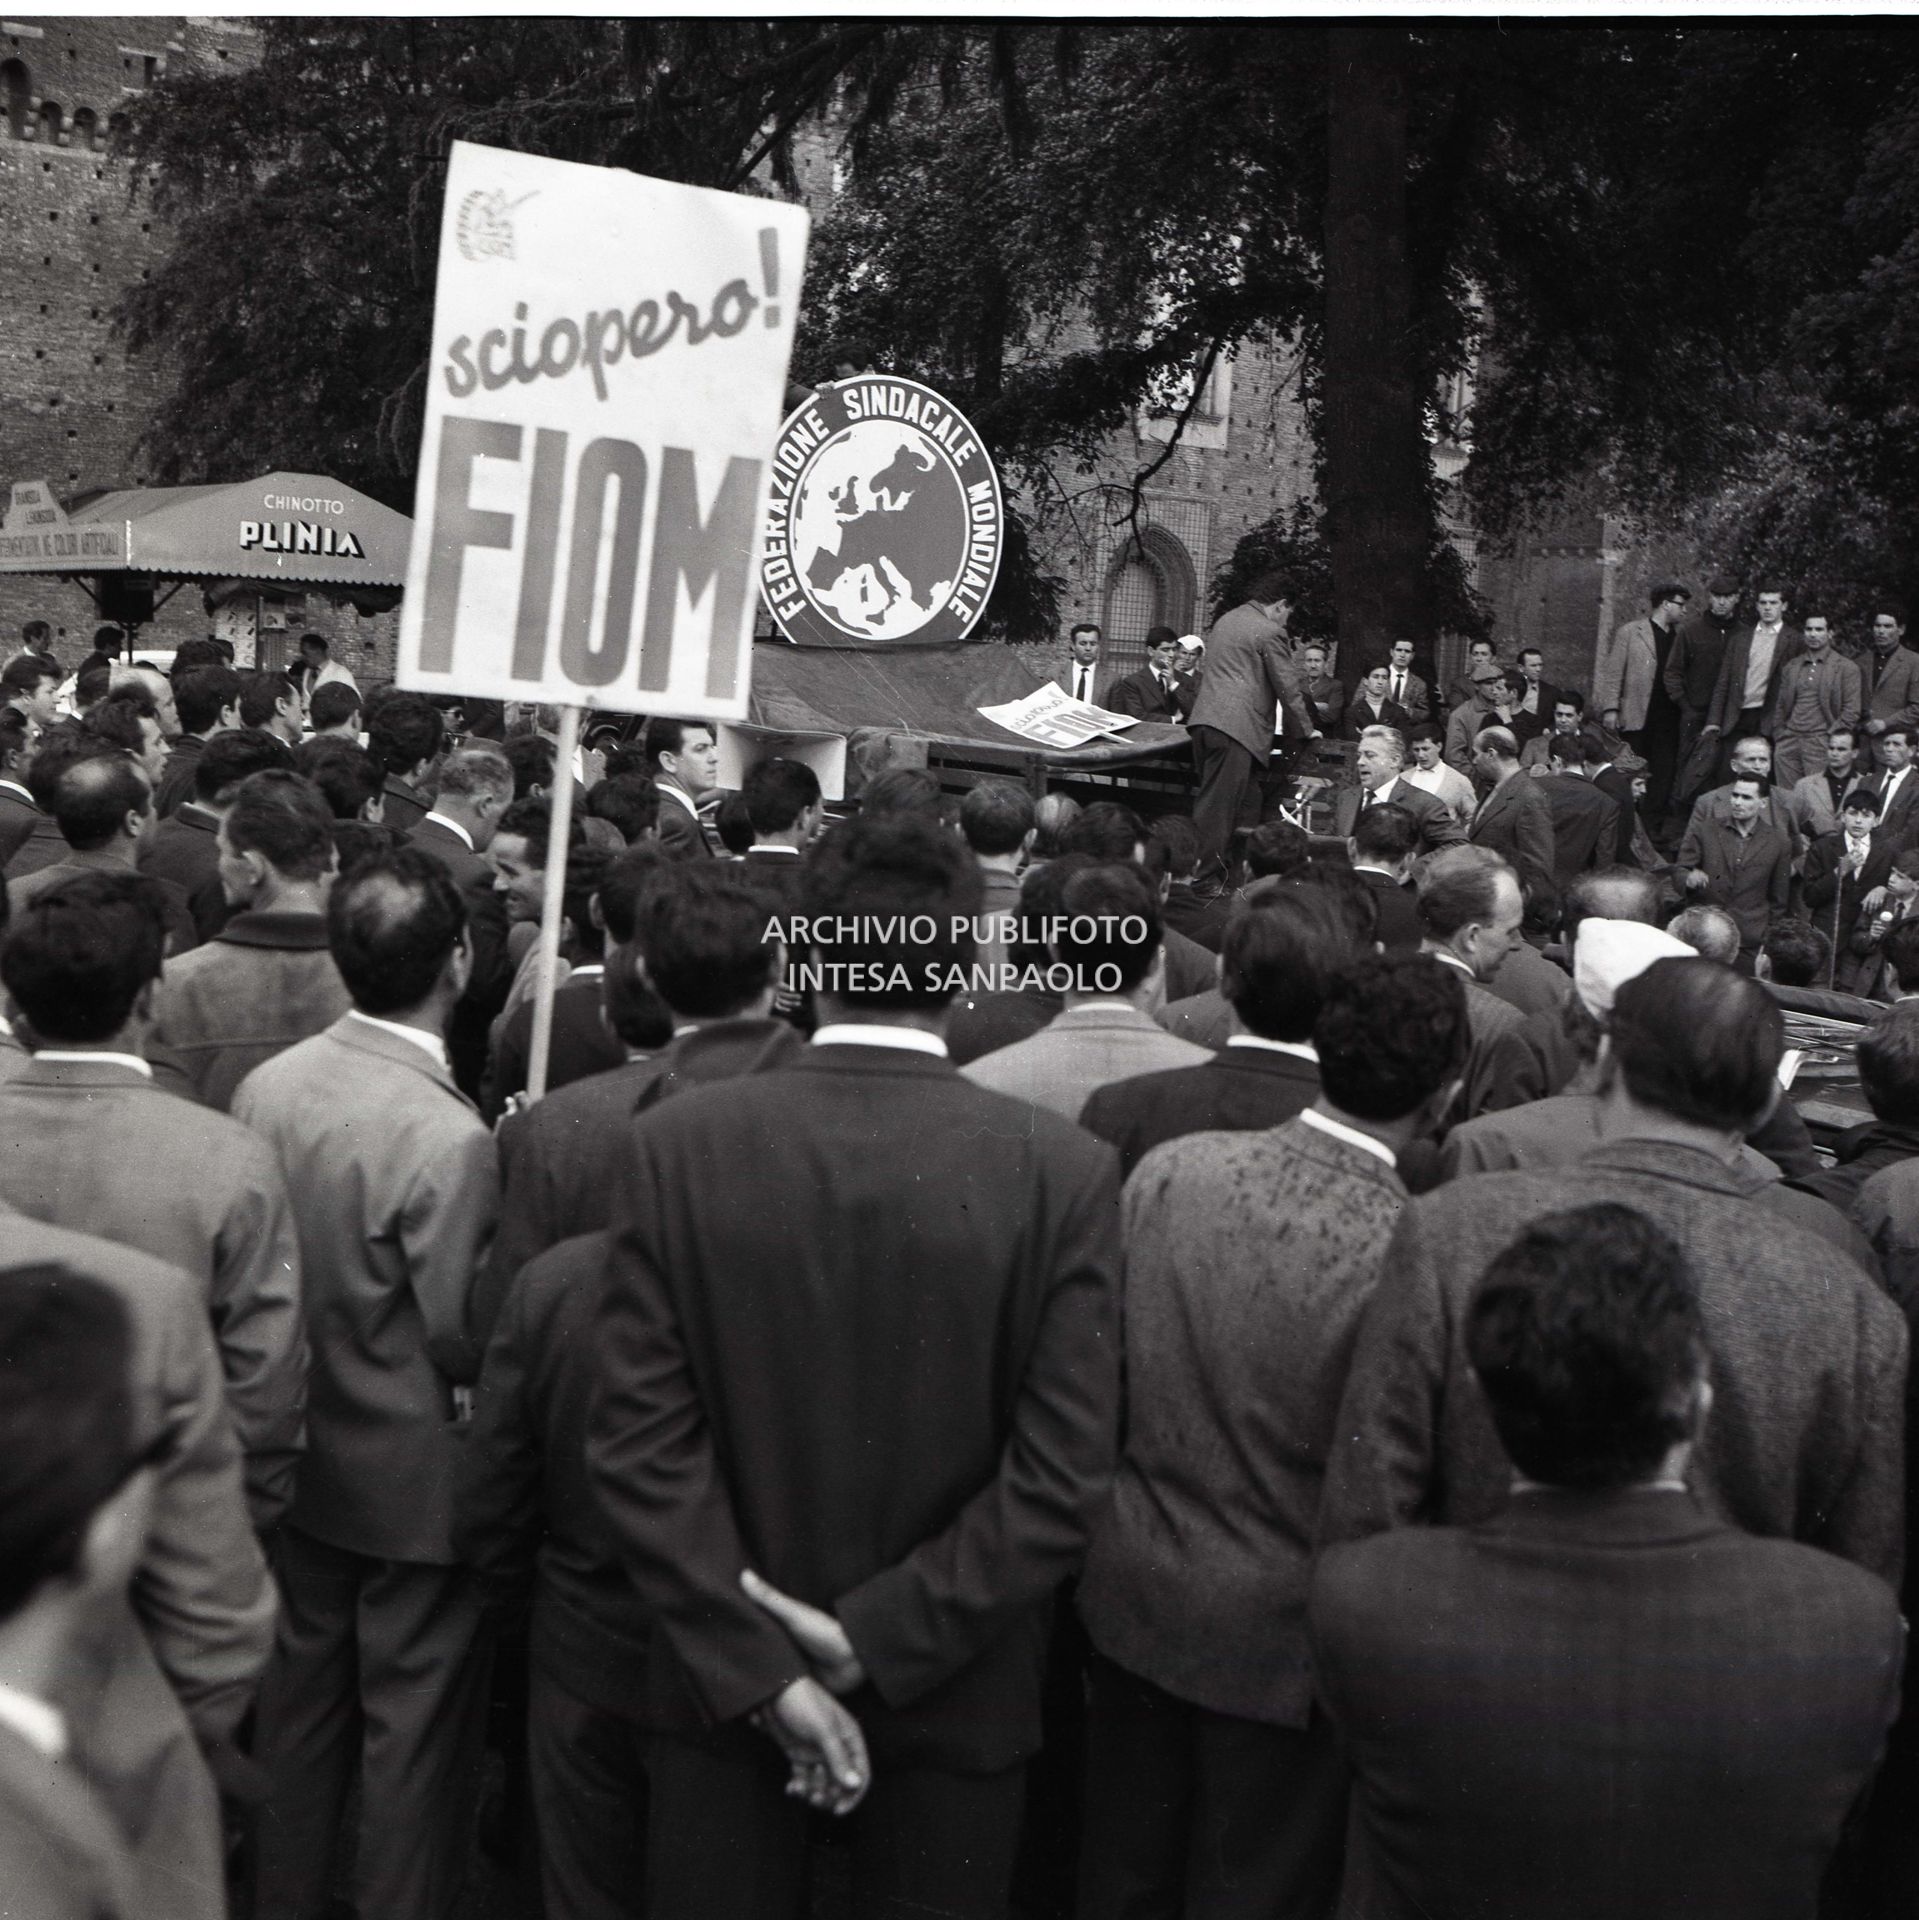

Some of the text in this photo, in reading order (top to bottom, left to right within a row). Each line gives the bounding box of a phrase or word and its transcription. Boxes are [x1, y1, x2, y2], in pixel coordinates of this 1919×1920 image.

[443, 227, 781, 402] sciopero!
[239, 520, 363, 557] PLINIA
[263, 494, 345, 515] CHINOTTO
[418, 414, 764, 700] FIOM
[763, 385, 996, 623] FEDERAZIONE SINDACALE MONDIALE
[1022, 706, 1135, 747] FIOM
